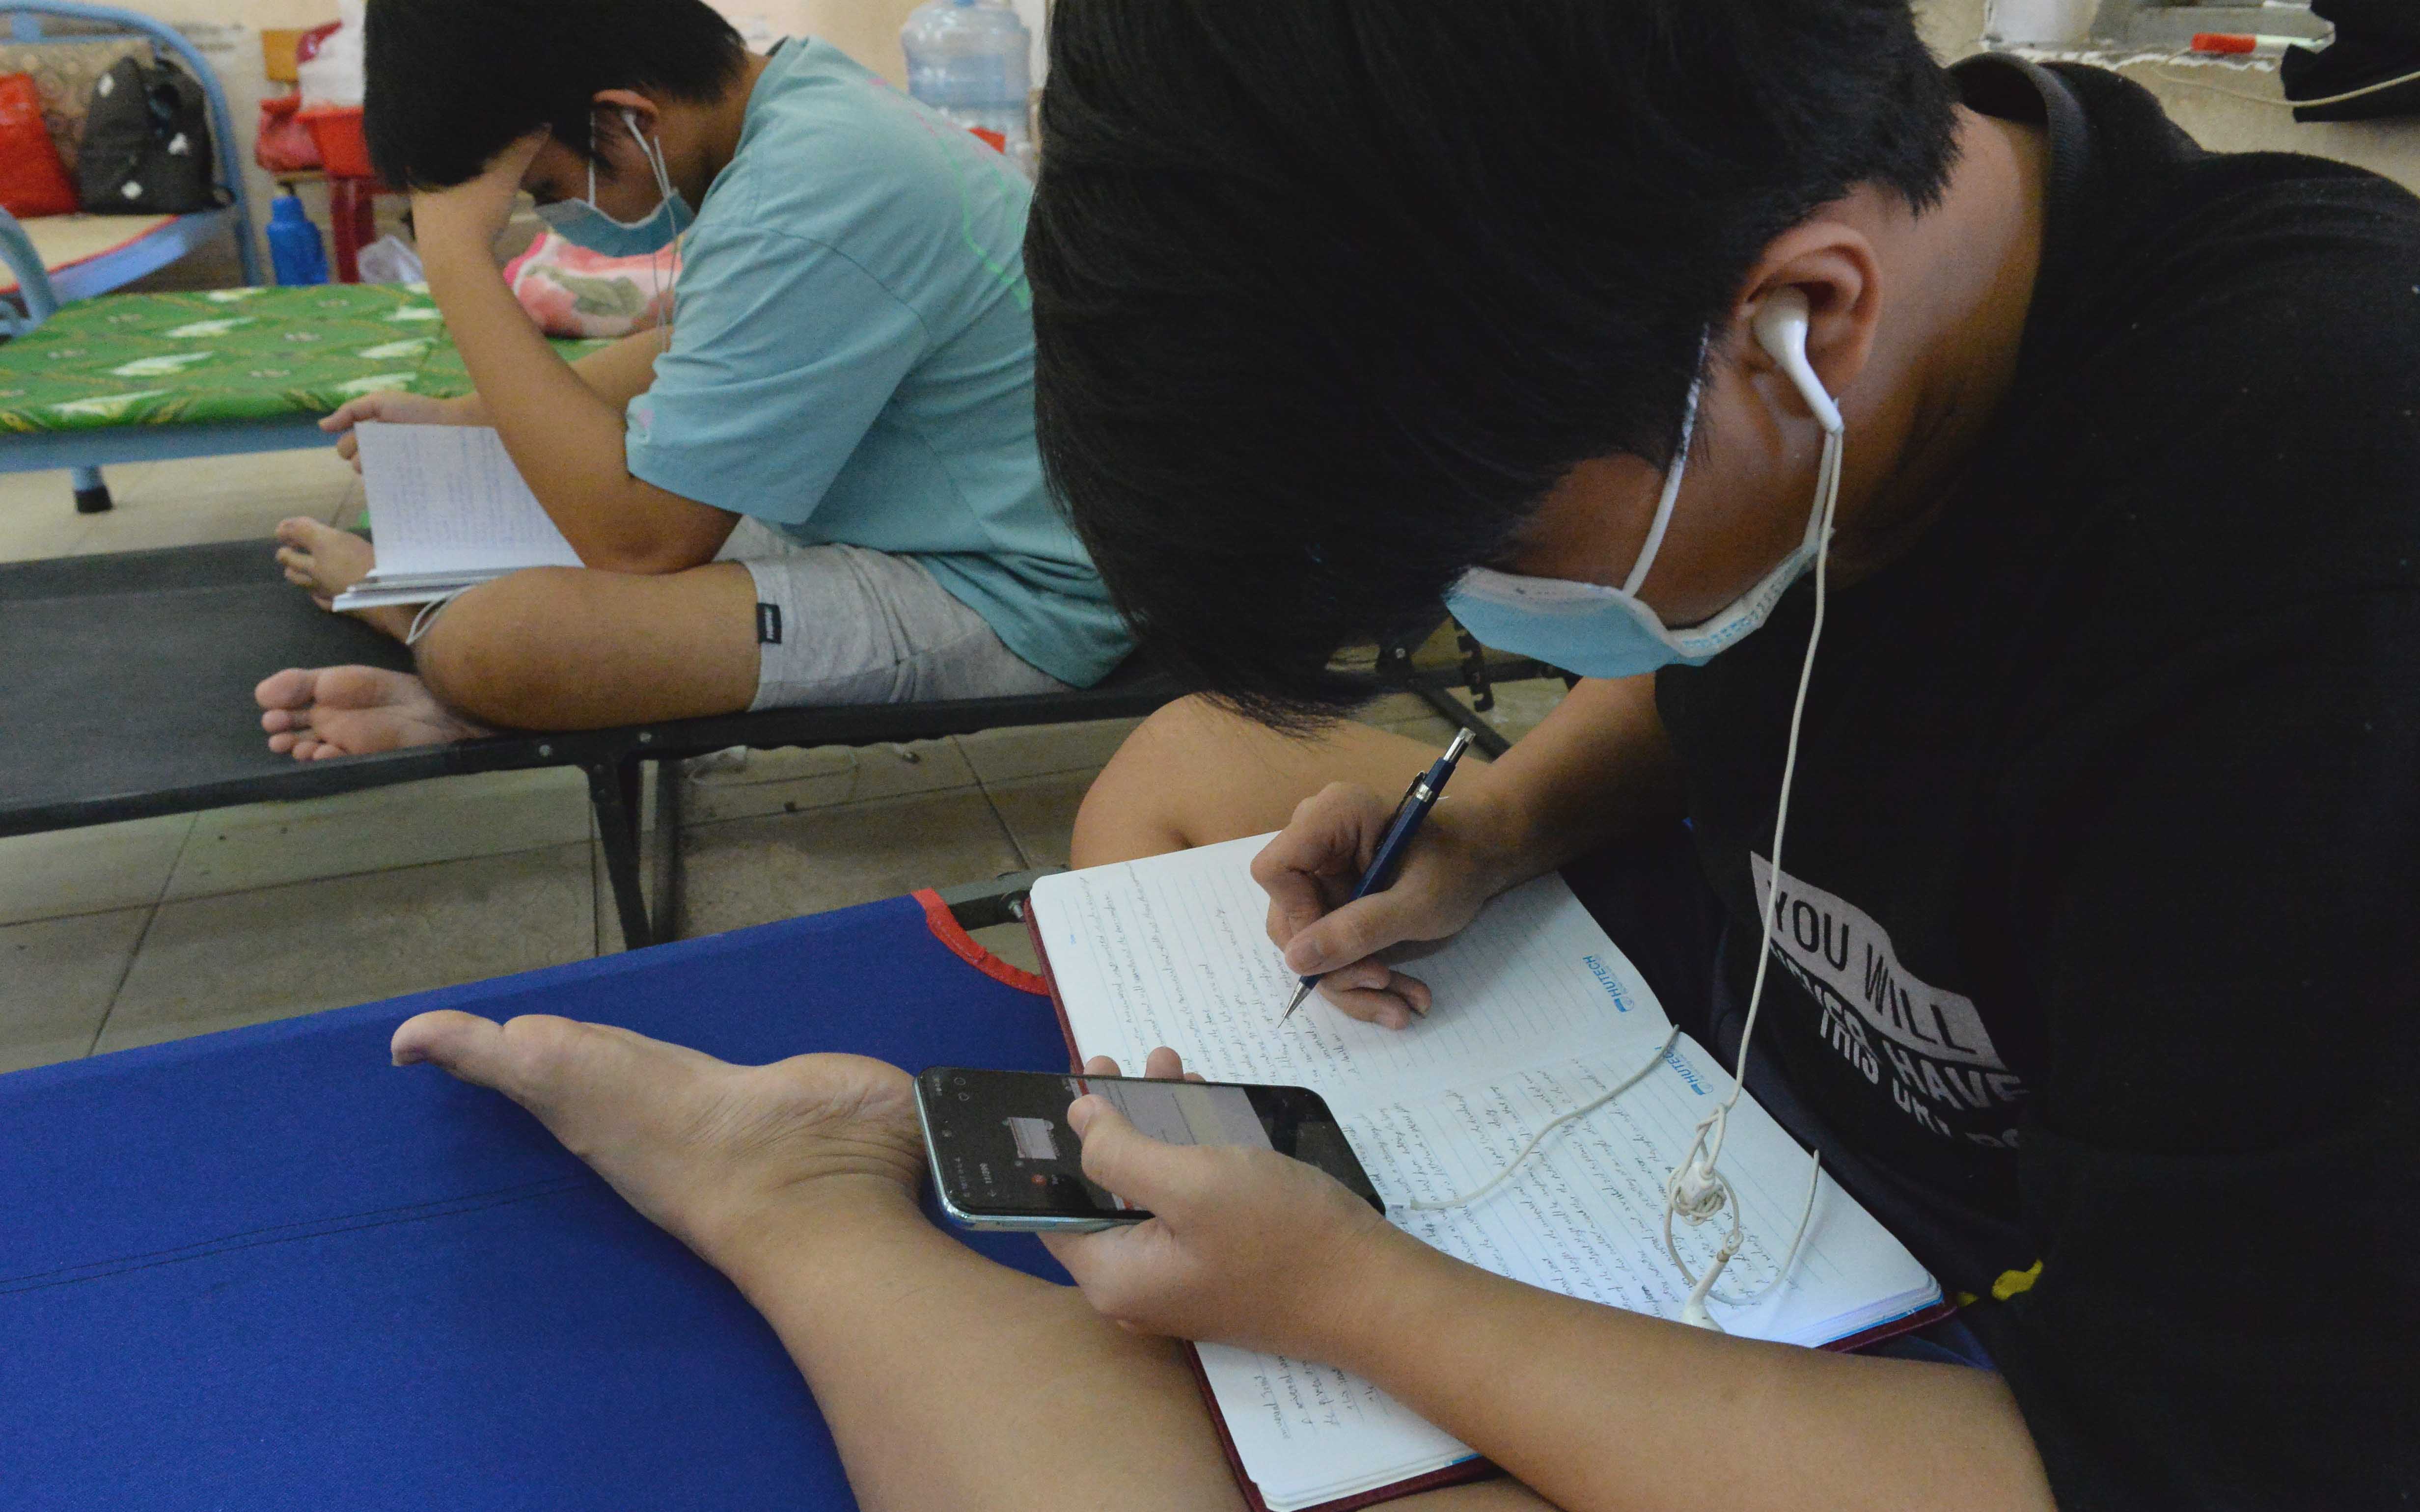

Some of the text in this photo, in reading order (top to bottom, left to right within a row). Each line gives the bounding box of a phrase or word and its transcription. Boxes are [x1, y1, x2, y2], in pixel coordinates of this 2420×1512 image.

[1582, 955, 1622, 999] HUTECH
[1767, 879, 1978, 1055] YOU WILL
[1654, 1045, 1699, 1086] HUTEC
